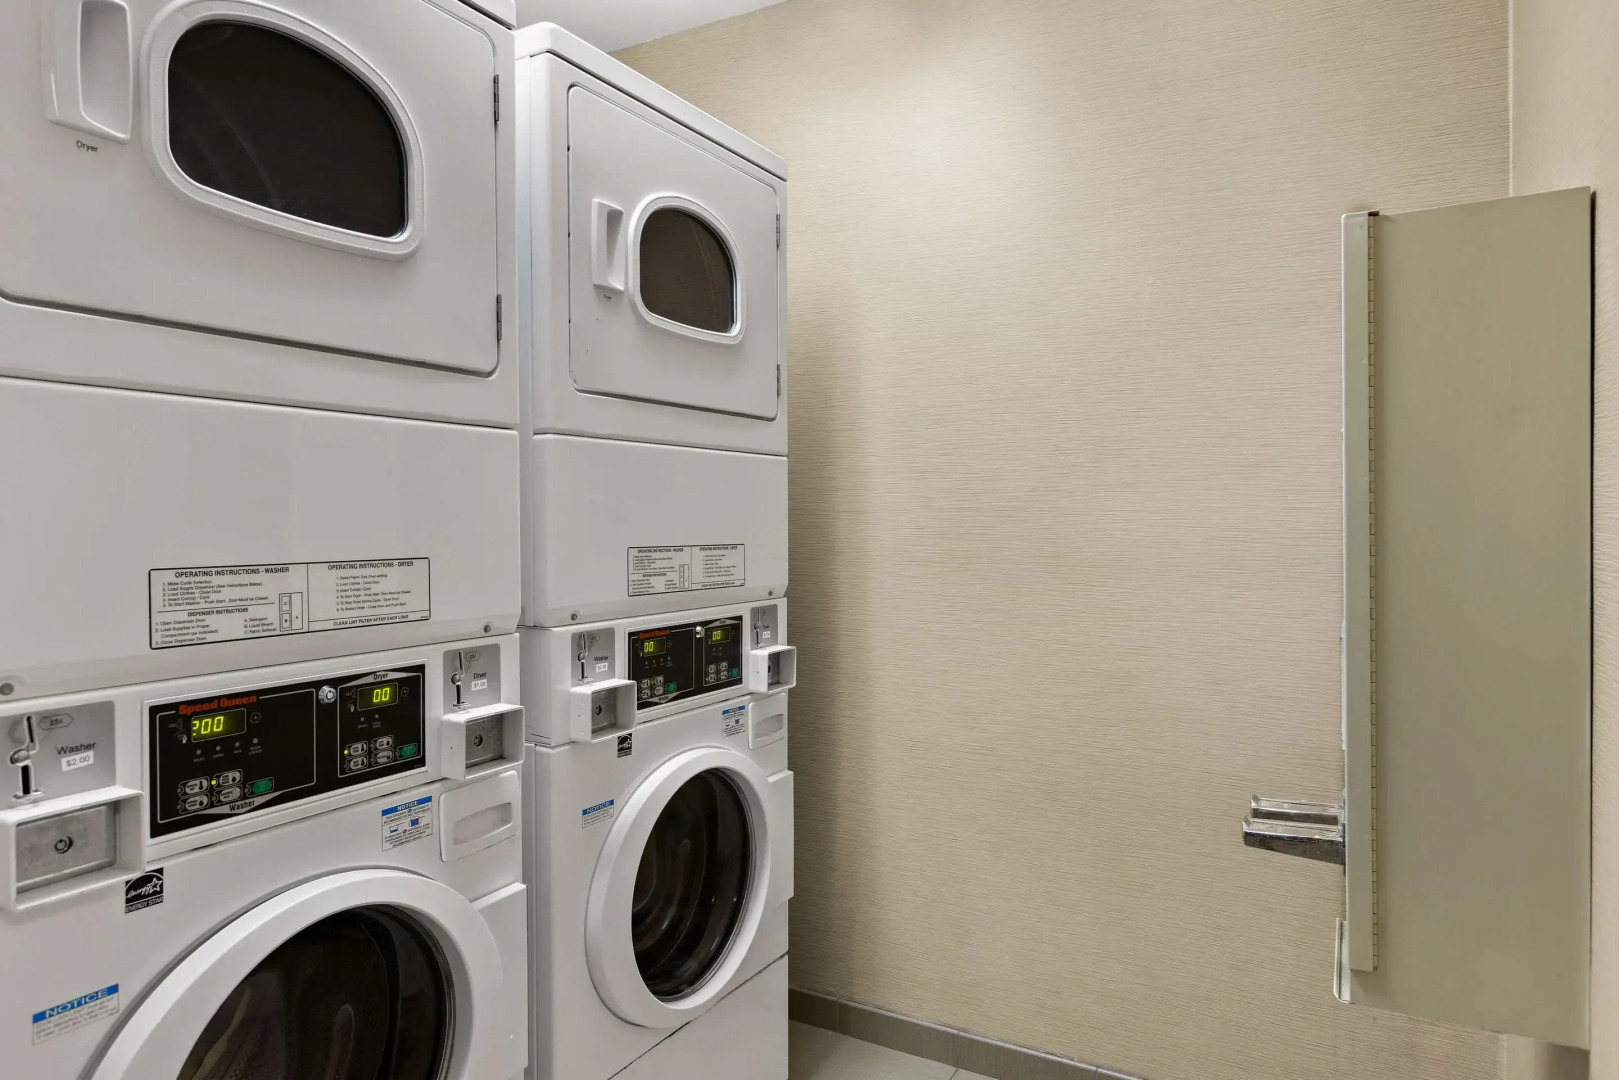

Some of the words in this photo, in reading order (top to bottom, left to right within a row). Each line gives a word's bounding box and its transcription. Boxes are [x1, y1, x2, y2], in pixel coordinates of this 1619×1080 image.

[76, 140, 98, 152] Dryer
[214, 568, 260, 576] INSTRUCTIONS
[373, 688, 390, 702] 00
[178, 700, 218, 715] Speed
[220, 695, 257, 707] Queen
[56, 742, 96, 755] Washer
[66, 755, 90, 767] $2.00
[229, 800, 256, 812] Washer
[397, 800, 418, 811] NOTICE
[586, 802, 610, 814] NOTICE
[45, 988, 108, 1018] NOTICE
